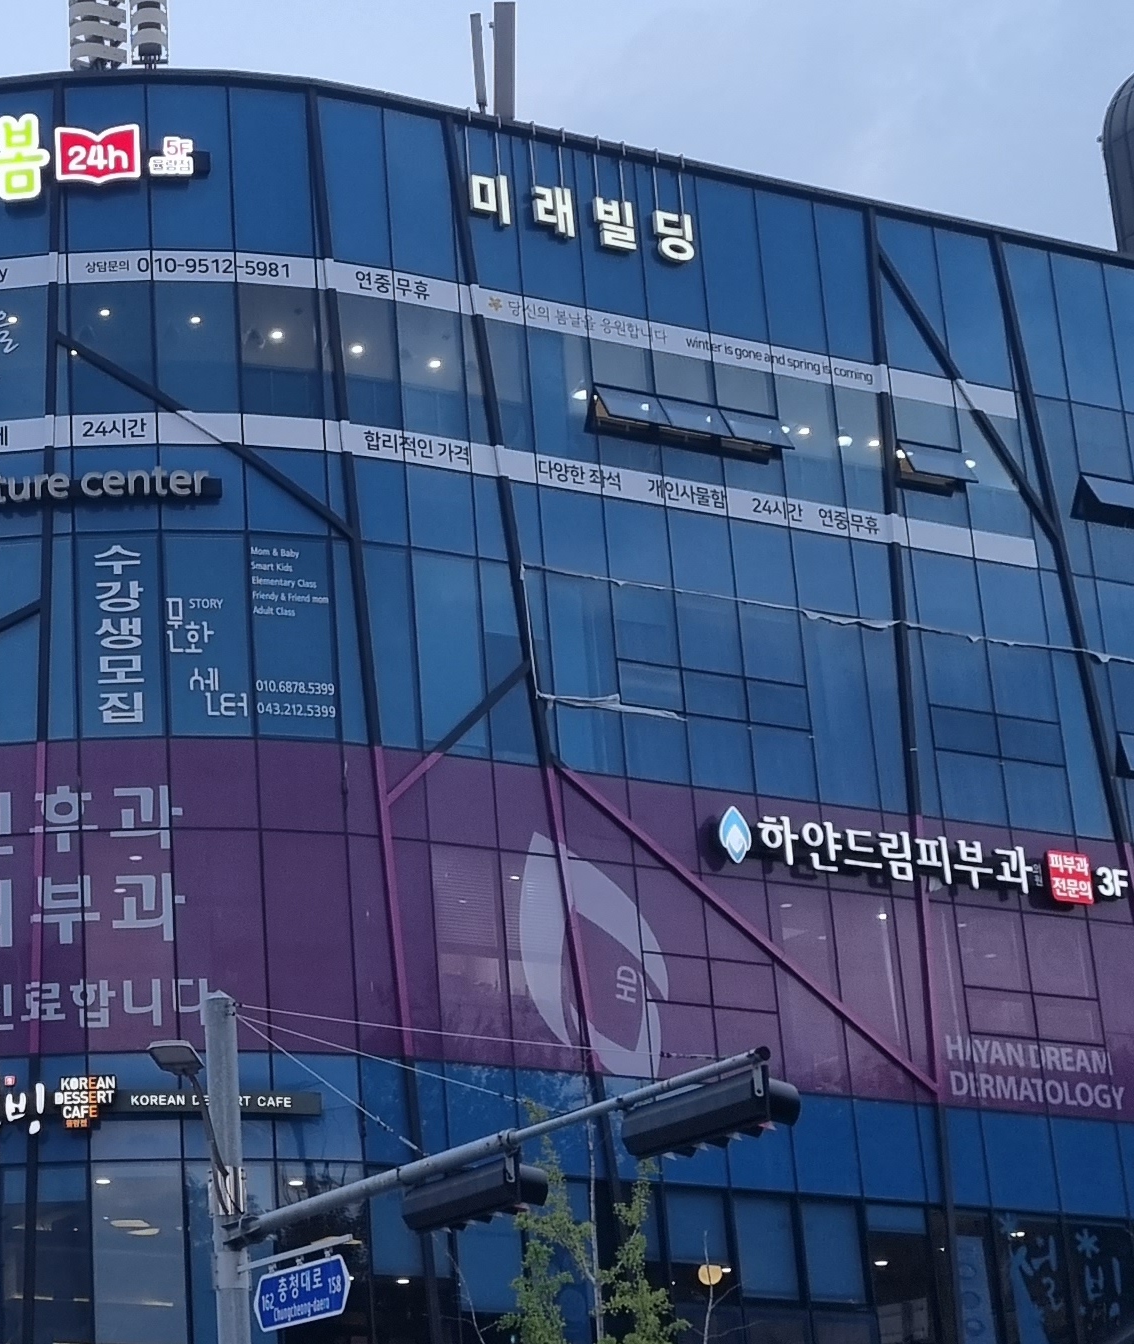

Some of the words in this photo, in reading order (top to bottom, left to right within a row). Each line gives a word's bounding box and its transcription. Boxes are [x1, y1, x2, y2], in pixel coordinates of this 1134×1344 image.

[68, 143, 128, 173] 24h
[165, 139, 190, 155] 5F
[469, 173, 695, 262] 미래빌딩
[85, 259, 130, 274] 상담문의
[136, 256, 291, 279] 010-9512-5981
[355, 269, 431, 301] 연중무휴
[506, 299, 551, 324] 당신의
[553, 305, 598, 333] 봄날을
[599, 314, 669, 347] 응원합니다
[686, 334, 723, 356] winter
[734, 345, 763, 364] gone
[764, 347, 785, 366] and
[786, 352, 821, 374] spring
[833, 363, 874, 386] coming
[82, 417, 147, 439] 24시간
[364, 429, 435, 464] 합리적인
[437, 438, 470, 466] 가격
[86, 466, 210, 498] center
[538, 459, 585, 488] 다양한
[589, 464, 622, 494] 좌석
[647, 476, 728, 514] 개인사물함
[752, 495, 804, 524] 24시간
[817, 505, 880, 538] 연중무휴
[250, 546, 271, 558] Mom
[280, 548, 300, 560] Baby
[250, 561, 275, 573] Smart
[276, 562, 294, 574] Kids
[251, 576, 296, 590] Elementary
[297, 578, 317, 590] Class
[188, 598, 224, 610] STORY
[287, 593, 311, 604] Friend
[253, 605, 274, 617] Adult
[275, 606, 296, 618] Class
[93, 544, 145, 724] 수강생모집
[255, 680, 336, 697] 010.6878.5399
[256, 702, 337, 719] 043.212.5399
[758, 816, 1032, 895] 하얀드림피부과
[1049, 853, 1090, 878] 피부과
[1051, 877, 1093, 901] 전문의
[1097, 866, 1129, 899] 3F
[945, 1034, 1025, 1070] HAYAN
[1031, 1044, 1113, 1076] DREAM
[60, 1075, 116, 1090] KOREAN
[950, 1069, 1126, 1111] DERMATOLOGY
[54, 1090, 115, 1105] DESSERT
[130, 1094, 186, 1106] KOREAN
[257, 1096, 292, 1109] CAFE
[62, 1105, 98, 1119] CAFE
[278, 1267, 323, 1303] 충청대로
[327, 1274, 342, 1295] 158
[261, 1292, 275, 1312] 162
[273, 1297, 330, 1323] Chungcheong-daero
